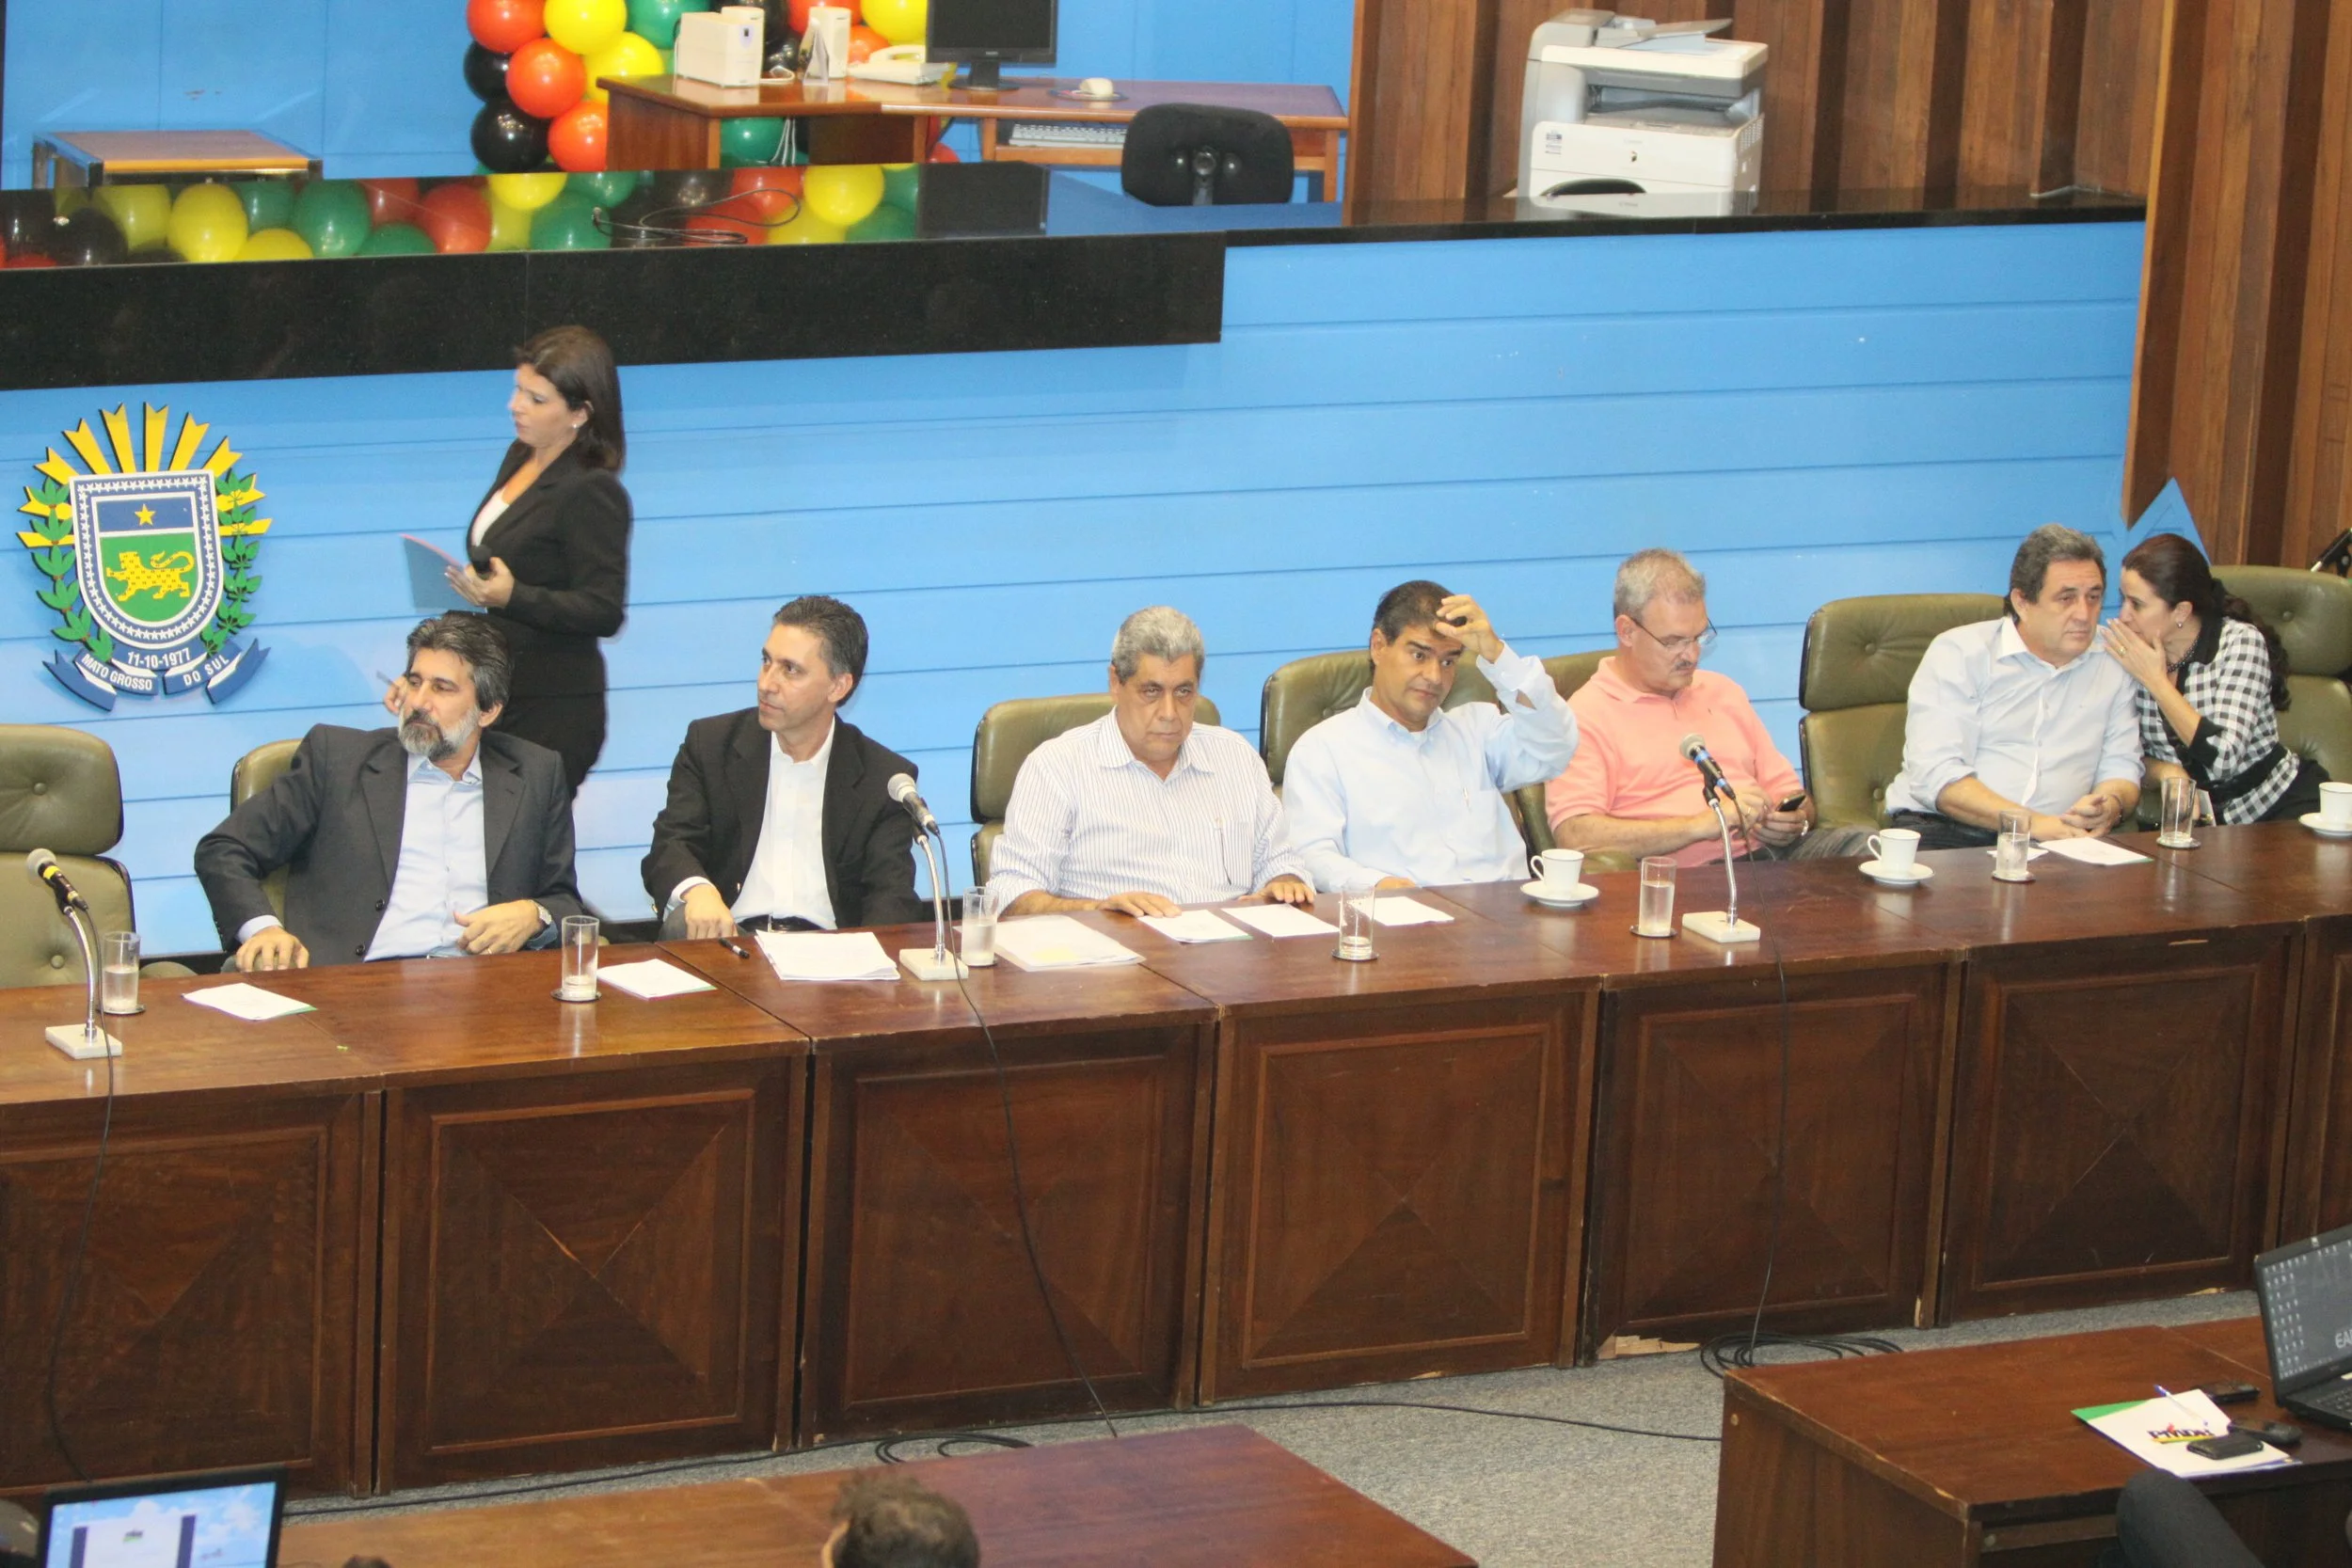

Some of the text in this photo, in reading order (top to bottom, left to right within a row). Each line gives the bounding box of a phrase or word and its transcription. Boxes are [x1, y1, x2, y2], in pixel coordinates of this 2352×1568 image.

[81, 653, 230, 690] MATO GROSSO DO SUL
[127, 647, 191, 669] 11-10-1977
